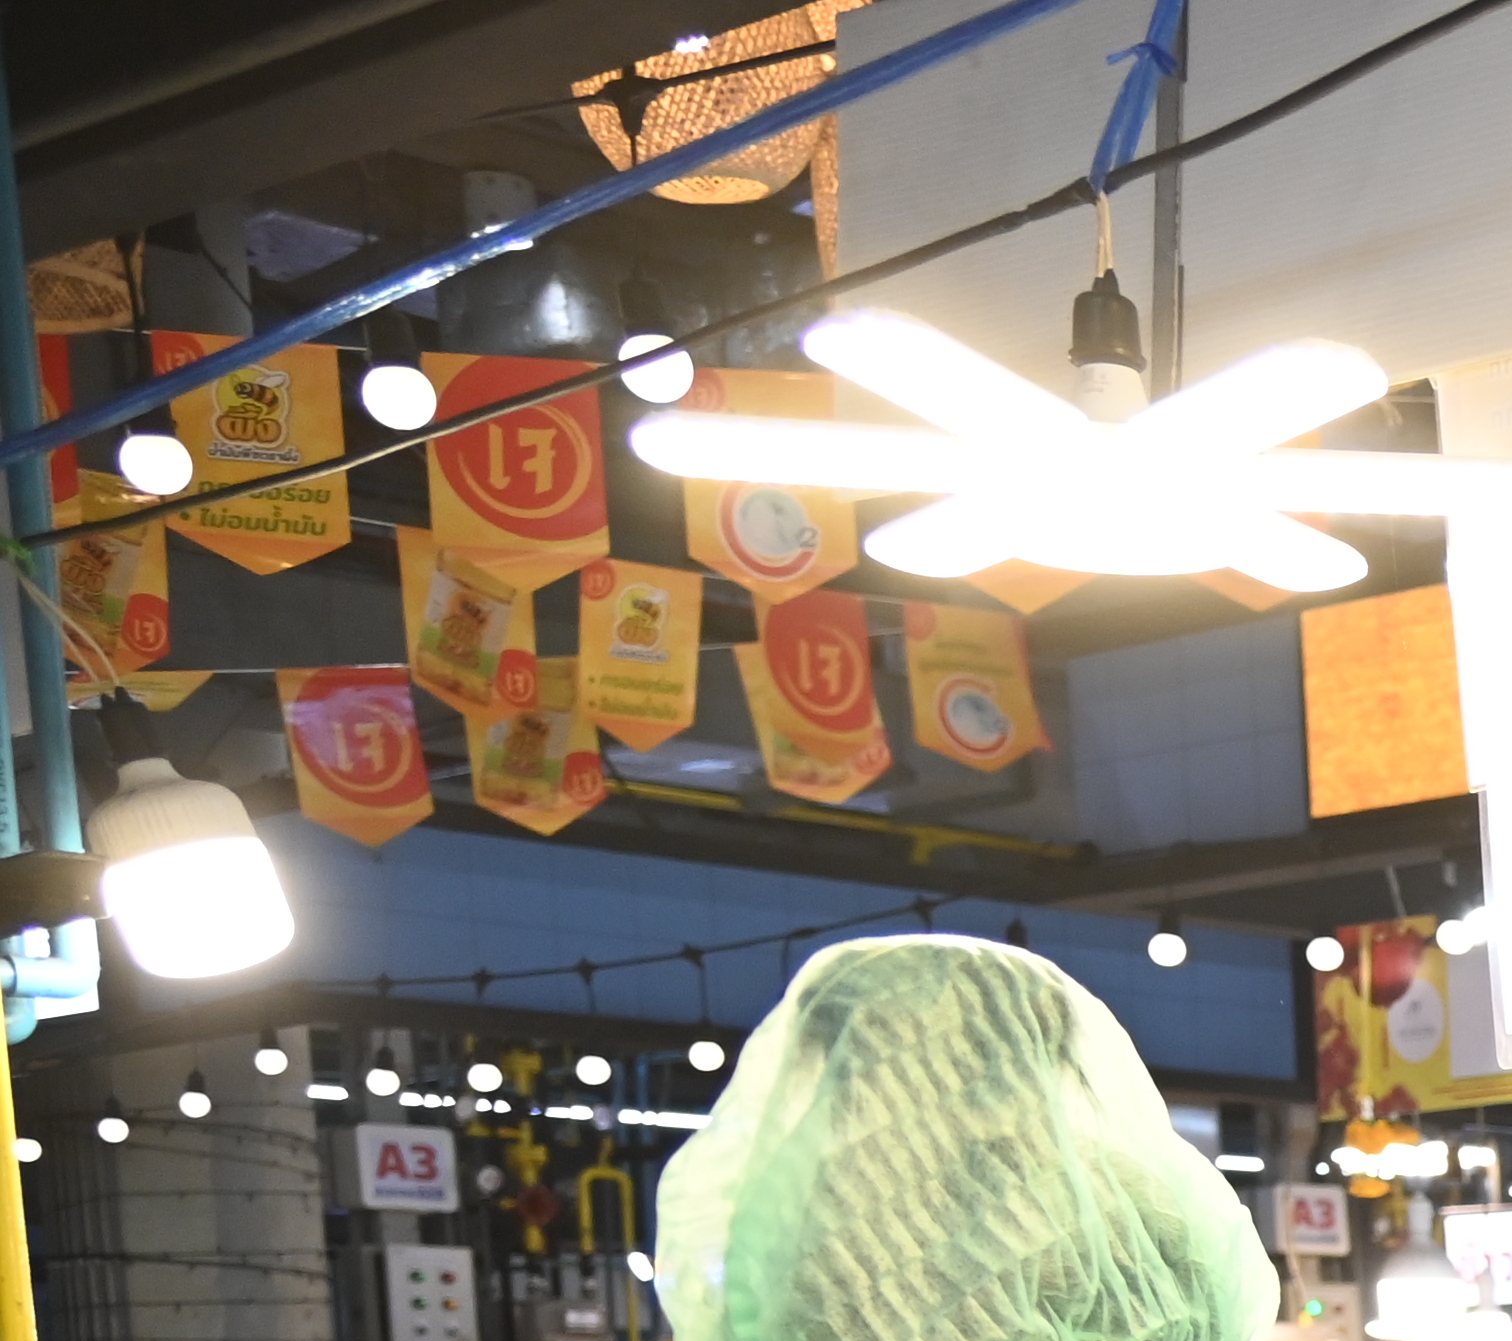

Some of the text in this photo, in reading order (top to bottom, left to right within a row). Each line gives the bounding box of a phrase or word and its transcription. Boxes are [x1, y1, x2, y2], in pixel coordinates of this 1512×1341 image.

[487, 420, 558, 495] เจ
[332, 720, 385, 774] เจ
[376, 1141, 439, 1182] A3
[1294, 1197, 1336, 1230] A3
